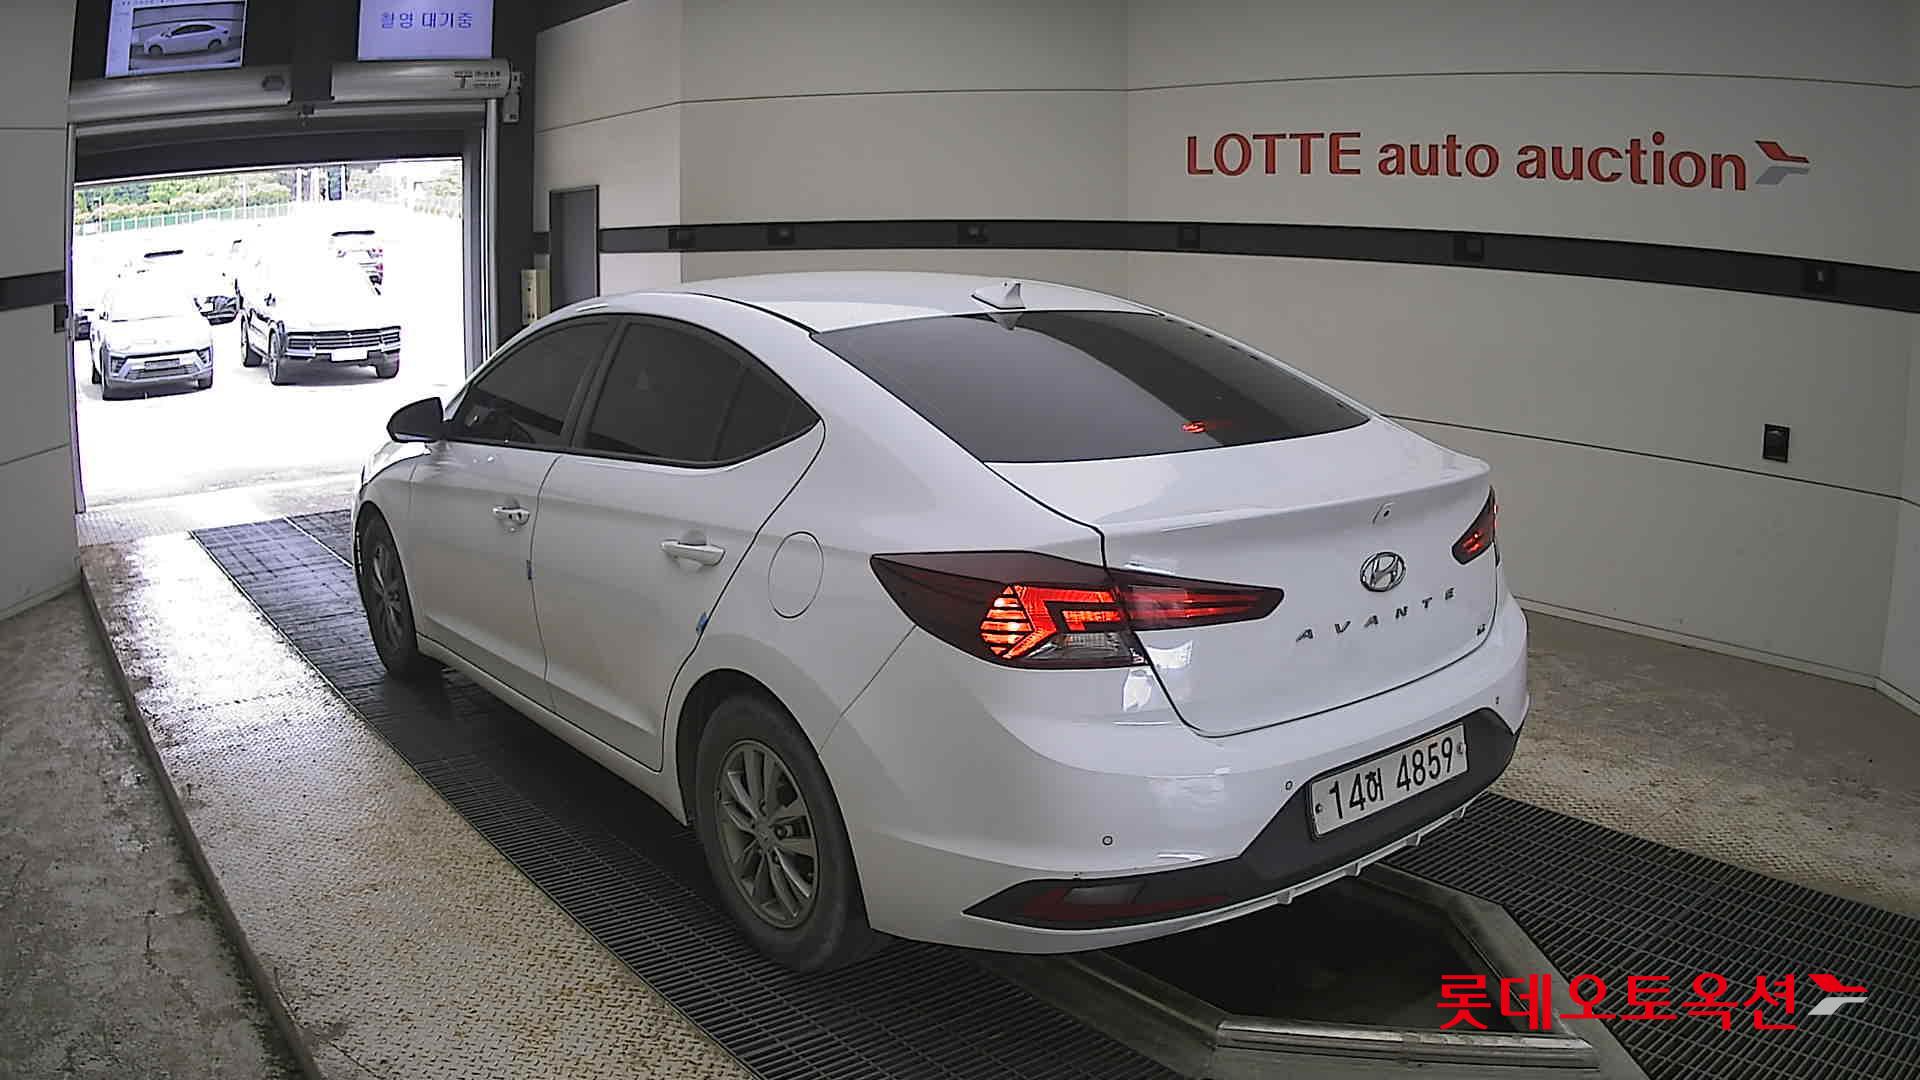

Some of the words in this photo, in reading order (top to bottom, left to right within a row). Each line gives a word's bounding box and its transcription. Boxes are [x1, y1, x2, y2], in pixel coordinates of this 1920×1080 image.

[421, 11, 472, 29] 대기중
[1187, 132, 1361, 177] LOTTE
[1378, 134, 1499, 178] auto
[1516, 131, 1746, 191] auction
[1296, 587, 1456, 643] AVANTE
[1328, 767, 1384, 820] 14허
[1396, 736, 1453, 792] 4859
